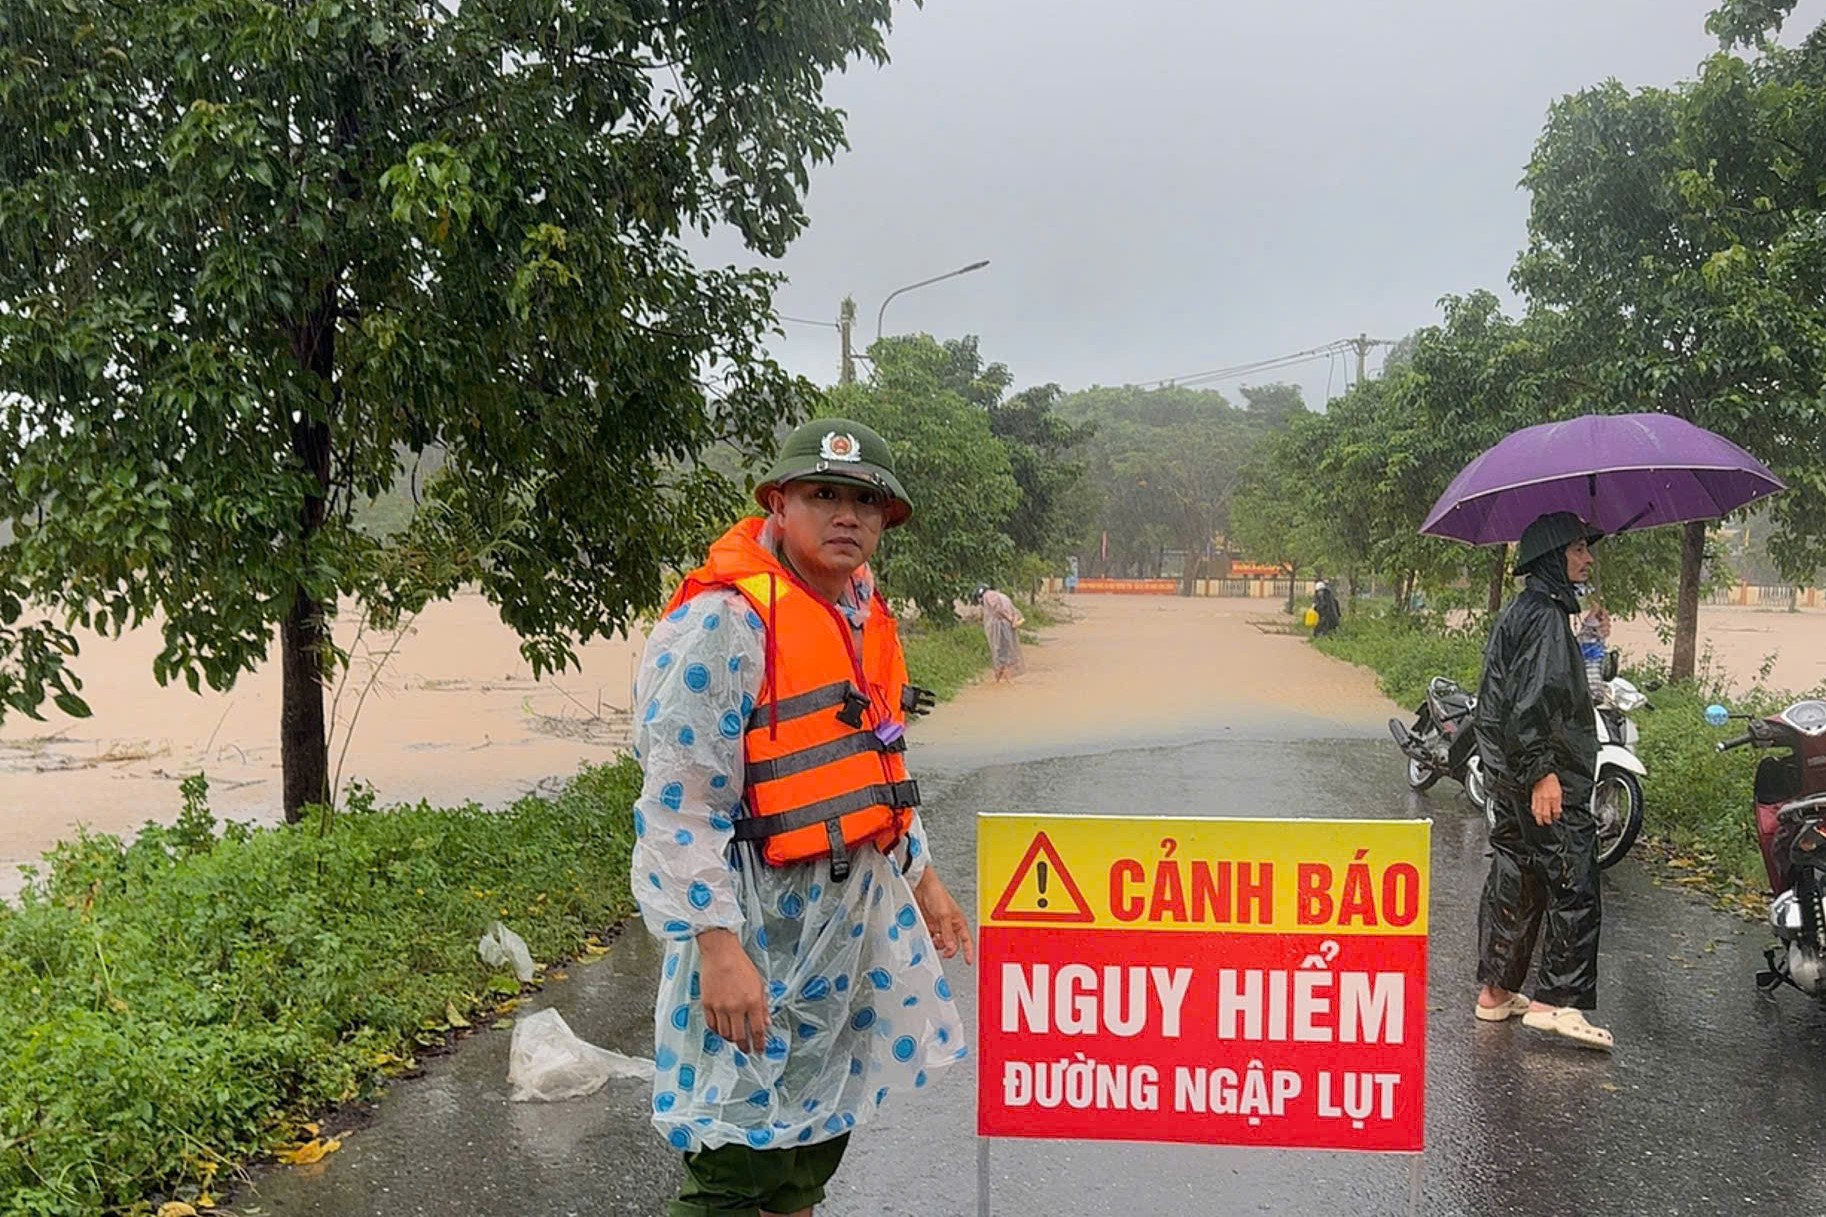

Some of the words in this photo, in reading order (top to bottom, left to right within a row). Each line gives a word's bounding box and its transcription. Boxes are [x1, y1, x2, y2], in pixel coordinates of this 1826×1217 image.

[1109, 838, 1274, 924] CẢNH
[1297, 849, 1419, 926] BÁO
[1001, 964, 1193, 1037] NGUY
[1218, 940, 1405, 1044] HIỂM
[1003, 1052, 1159, 1111] ĐƯỜNG
[1175, 1060, 1300, 1126] NGẬP
[1318, 1072, 1400, 1129] LỤT
